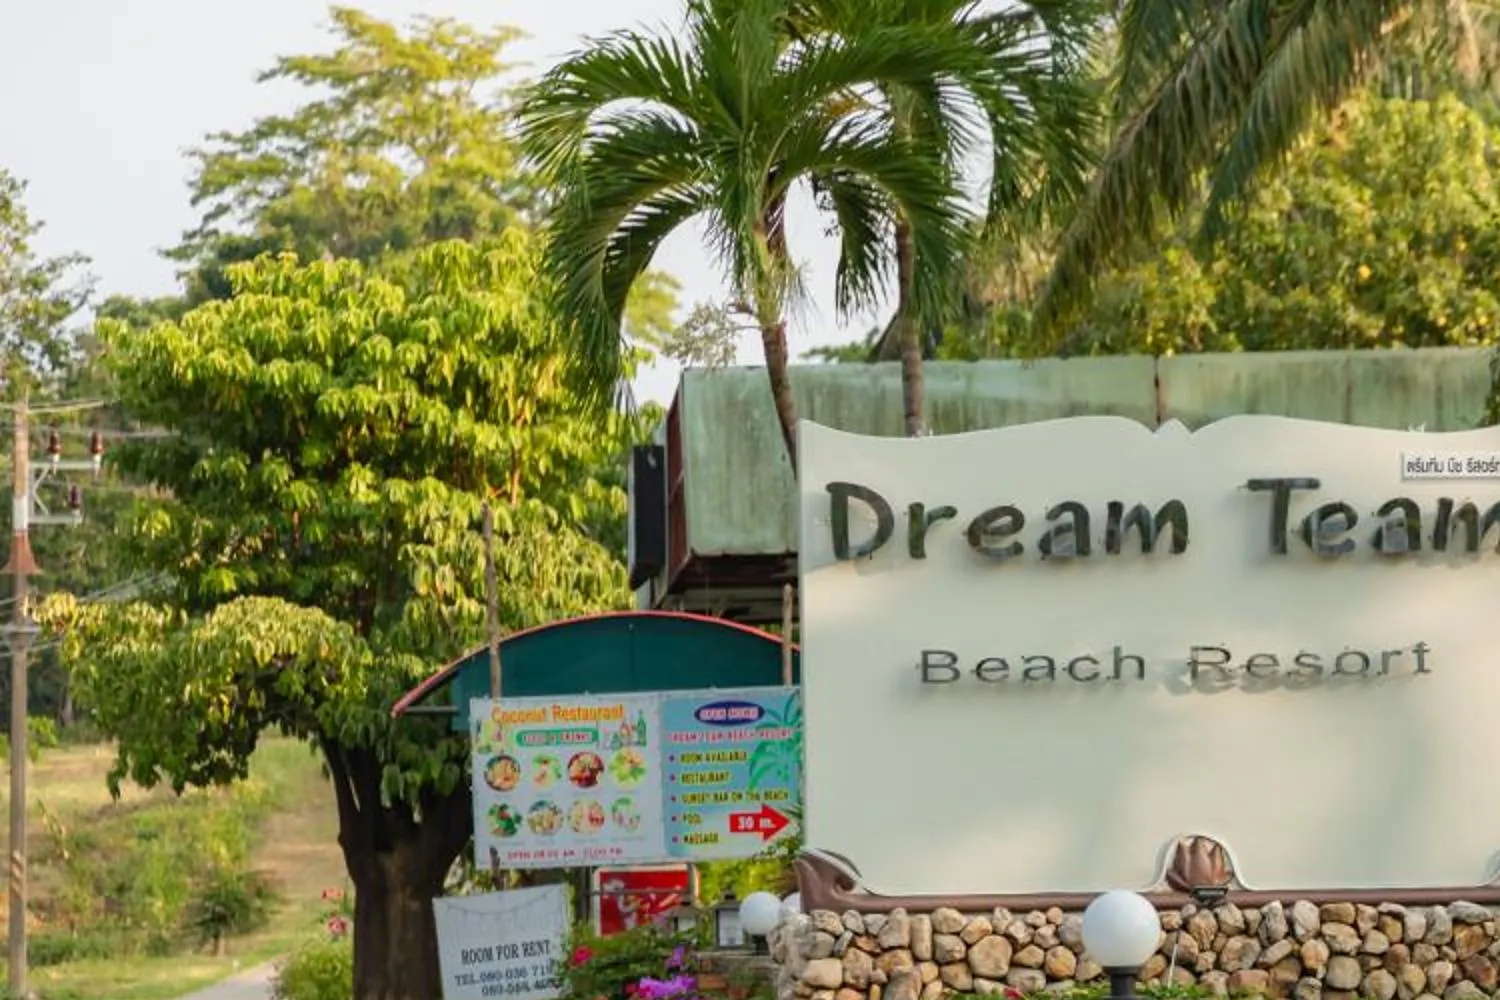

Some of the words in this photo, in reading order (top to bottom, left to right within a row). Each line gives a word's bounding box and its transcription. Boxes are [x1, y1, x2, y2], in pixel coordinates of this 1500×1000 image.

[825, 480, 1190, 562] Dream
[919, 645, 1147, 684] Beach
[1187, 641, 1433, 681] Resort
[491, 706, 546, 724] Coconut
[552, 703, 624, 722] Restaurant
[680, 752, 703, 764] ROOM
[680, 772, 731, 784] RESTAURANT
[682, 794, 711, 805] SUNSET
[714, 792, 729, 803] BAR
[731, 792, 743, 802] ON
[764, 790, 789, 801] BEACH
[682, 813, 702, 824] POOL
[461, 946, 494, 965] ROOM
[496, 943, 520, 961] FOR
[522, 938, 551, 957] RENT
